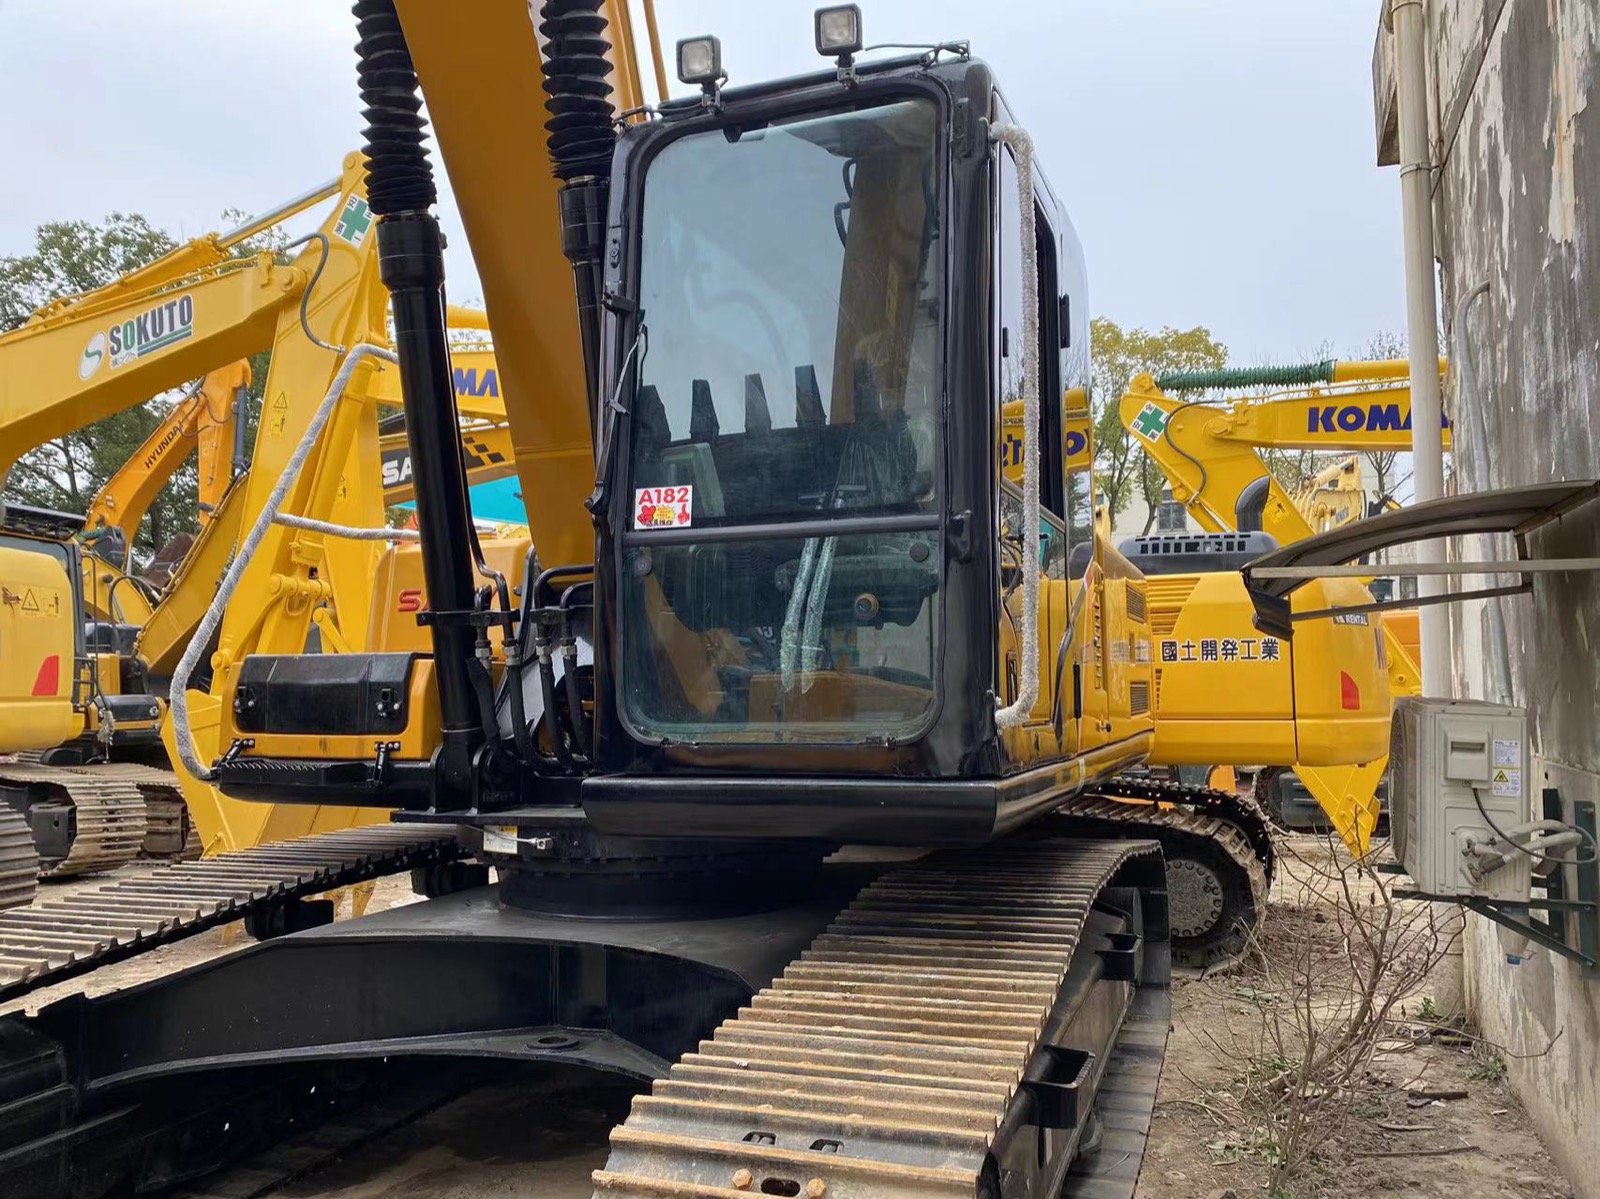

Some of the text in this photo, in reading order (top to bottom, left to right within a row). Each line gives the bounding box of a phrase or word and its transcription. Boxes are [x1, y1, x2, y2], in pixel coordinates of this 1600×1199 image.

[109, 294, 193, 356] SOKUTO
[638, 487, 689, 505] A182
[1345, 614, 1368, 626] RENTAL
[1161, 638, 1279, 662] 國土開発工業
